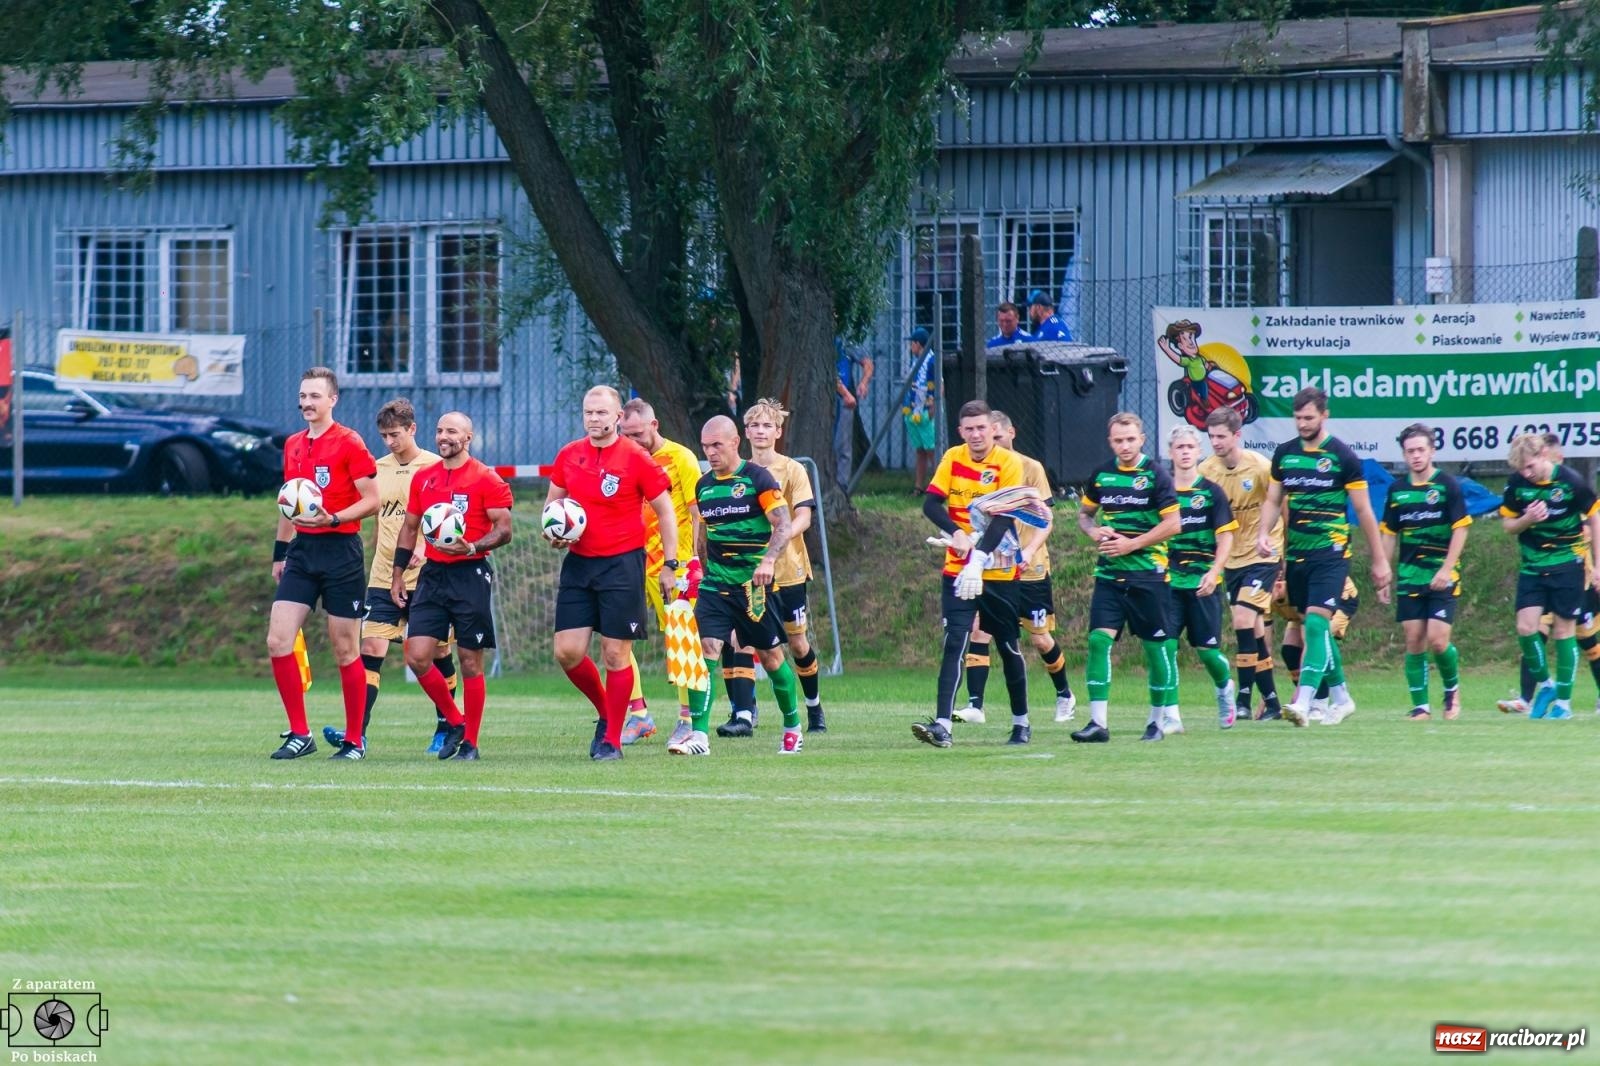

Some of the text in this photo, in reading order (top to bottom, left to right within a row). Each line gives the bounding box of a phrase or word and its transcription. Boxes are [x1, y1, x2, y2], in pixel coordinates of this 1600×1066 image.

[1265, 314, 1405, 327] Zakładanie trawników
[1432, 312, 1476, 326] Aeracja
[1530, 308, 1586, 322] Nawożenie
[1266, 336, 1351, 350] Wertykulacja
[1432, 333, 1503, 346] Piaskowanie
[1530, 331, 1570, 345] Wysiew
[1453, 426, 1499, 450] 668
[1558, 422, 1600, 447] 735
[793, 605, 806, 626] 15
[1032, 608, 1047, 628] 13
